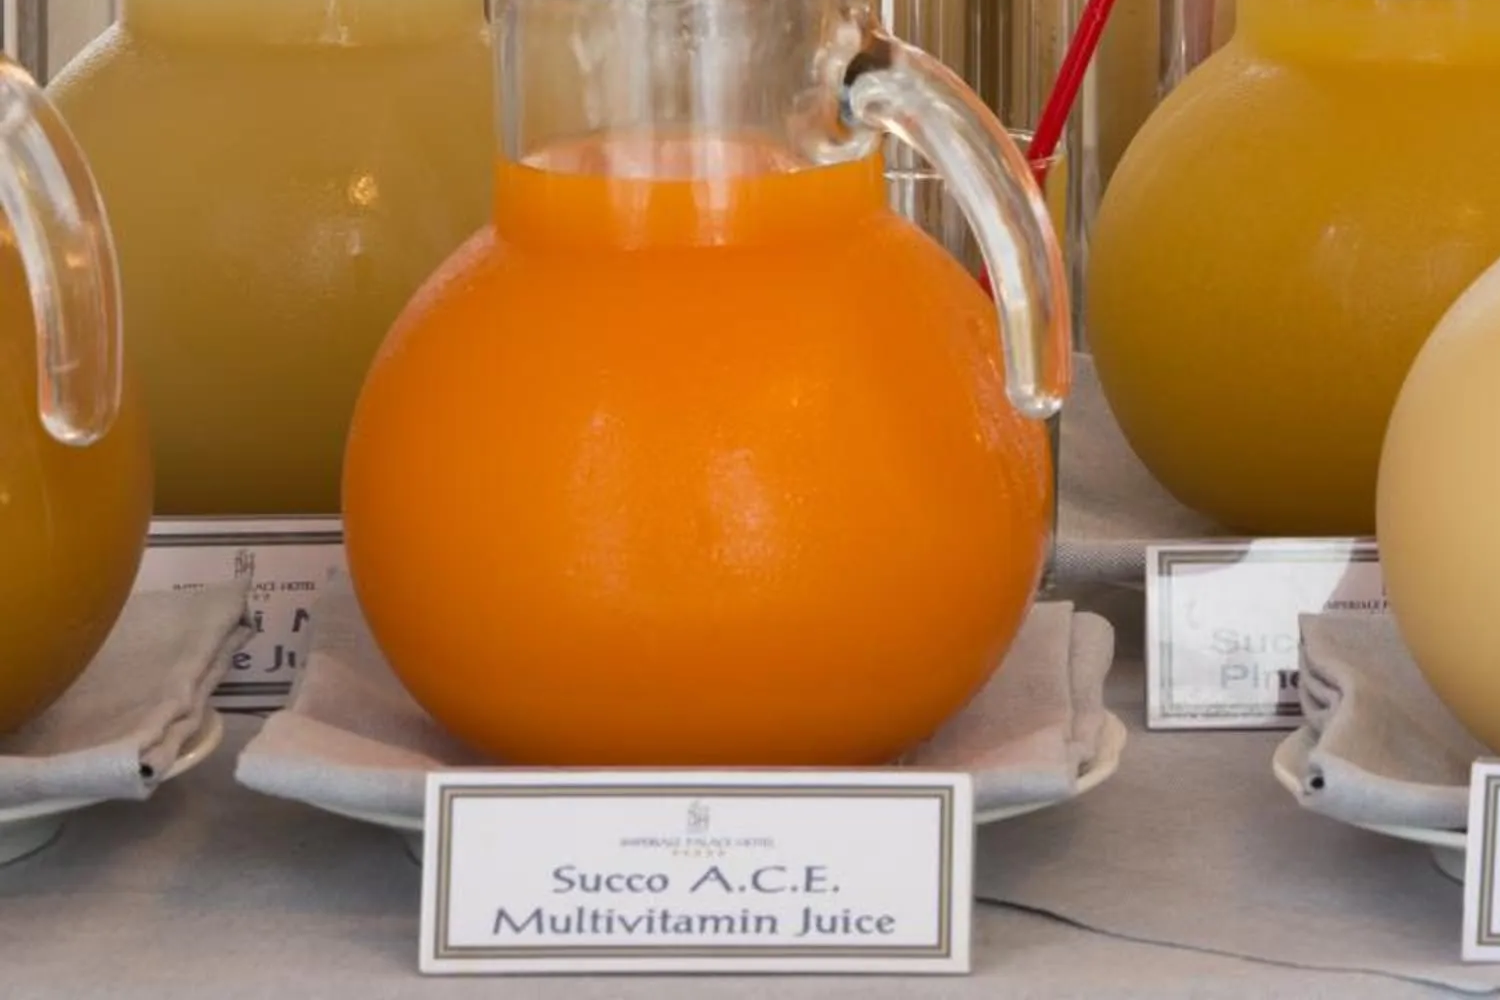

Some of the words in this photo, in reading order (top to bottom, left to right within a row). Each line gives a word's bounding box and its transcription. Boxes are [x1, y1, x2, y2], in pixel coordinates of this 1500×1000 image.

[552, 865, 669, 894] Succo
[689, 865, 840, 894] A.C.E.
[492, 905, 778, 936] Multivitamin
[795, 906, 896, 938] Juice
